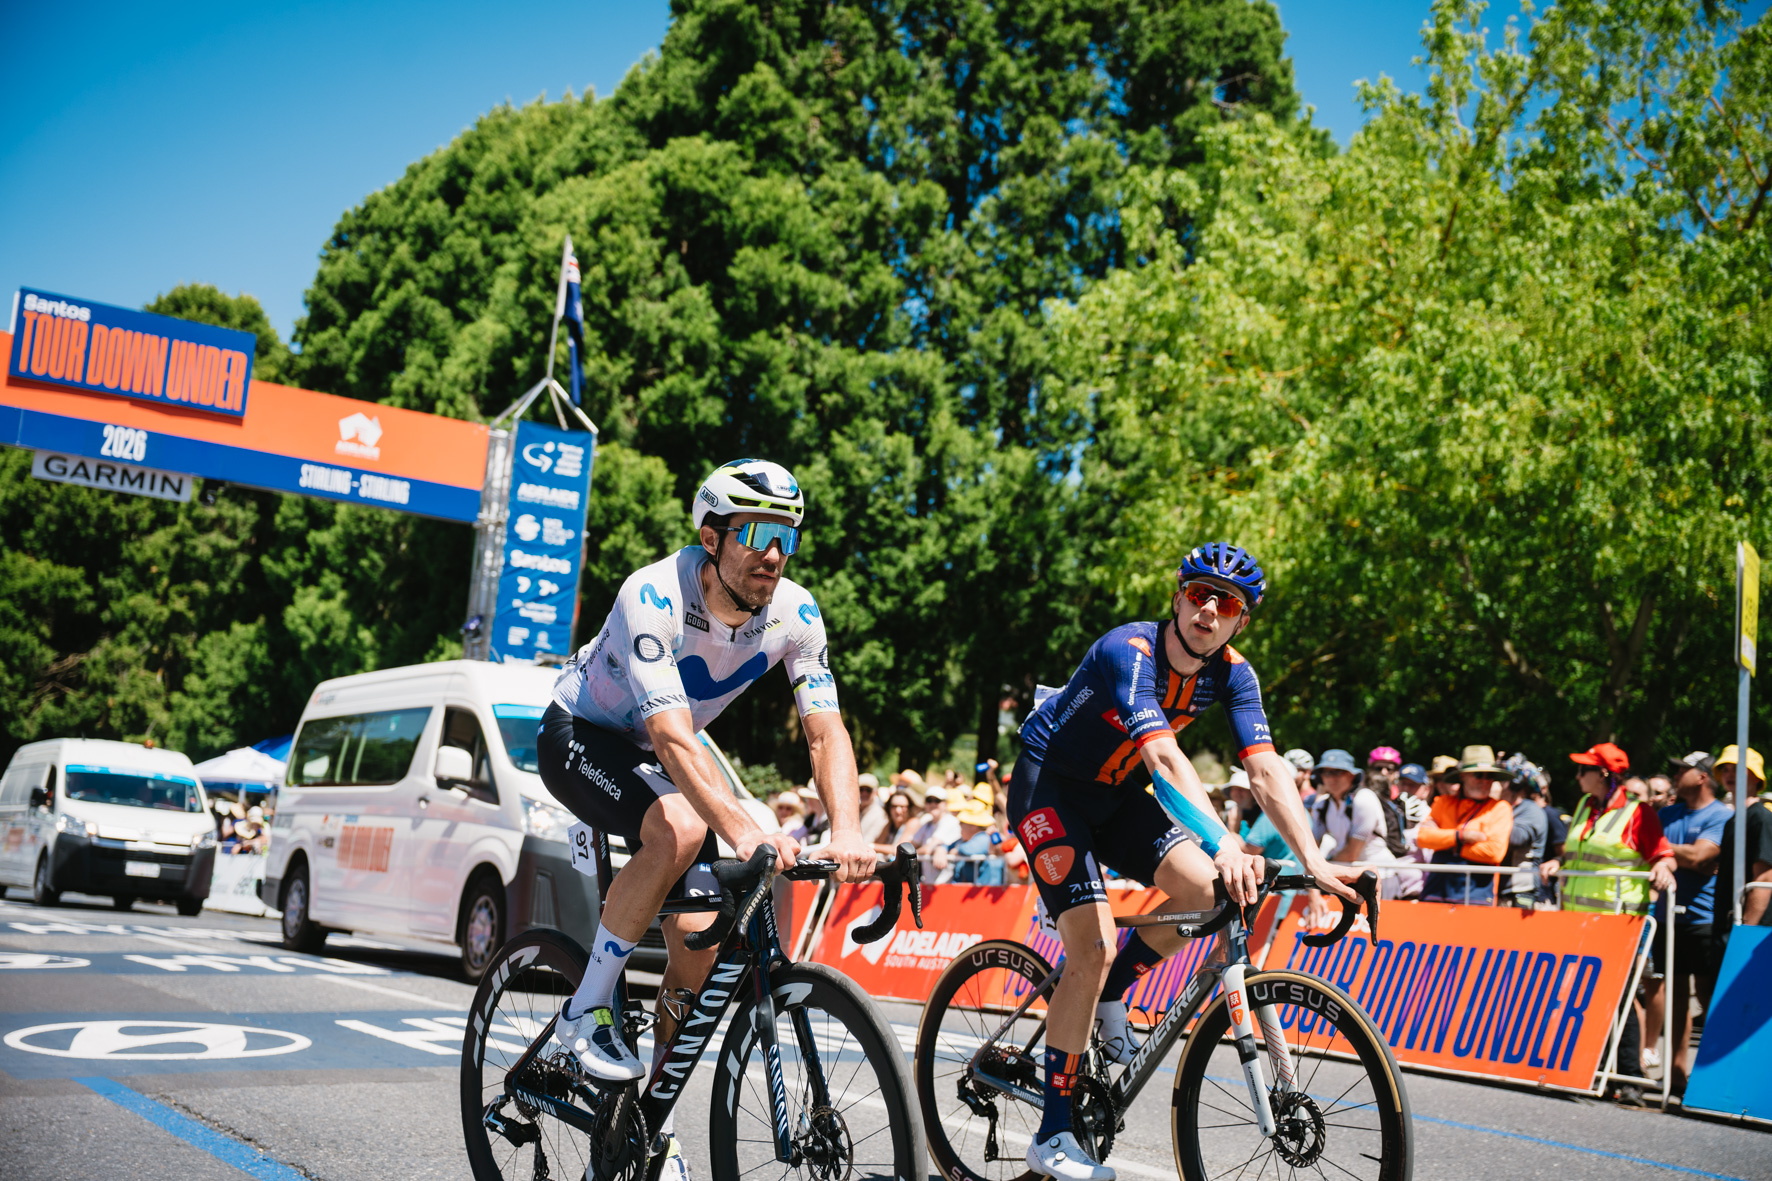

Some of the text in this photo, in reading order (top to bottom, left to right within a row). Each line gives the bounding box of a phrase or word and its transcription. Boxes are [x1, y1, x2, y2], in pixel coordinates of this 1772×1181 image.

[24, 294, 91, 322] Santos
[19, 310, 248, 411] TOUR DOWN UNDER
[100, 424, 148, 461] 2026
[44, 455, 183, 495] GARMIN
[702, 489, 716, 505] ABUS
[743, 617, 781, 640] CANYON
[640, 693, 688, 714] CANYO
[1058, 685, 1095, 726] HANS ANDERS
[1123, 707, 1159, 730] raisin
[577, 755, 623, 802] Telefónica
[1030, 812, 1054, 839] PIC
[575, 830, 589, 860] 97
[741, 884, 768, 926] SRAM
[762, 898, 775, 939] CANYON
[1156, 911, 1203, 923] LAPIERRE
[883, 954, 951, 971] SOUTH AUSTR
[1350, 939, 1469, 1054] DOWN
[1453, 948, 1603, 1072] UNDER
[650, 962, 746, 1100] CANYON
[1119, 973, 1201, 1094] LAPIERRE
[515, 1088, 558, 1117] CANYON
[768, 1043, 788, 1140] CANYON
[1011, 1086, 1045, 1108] SHIMANO
